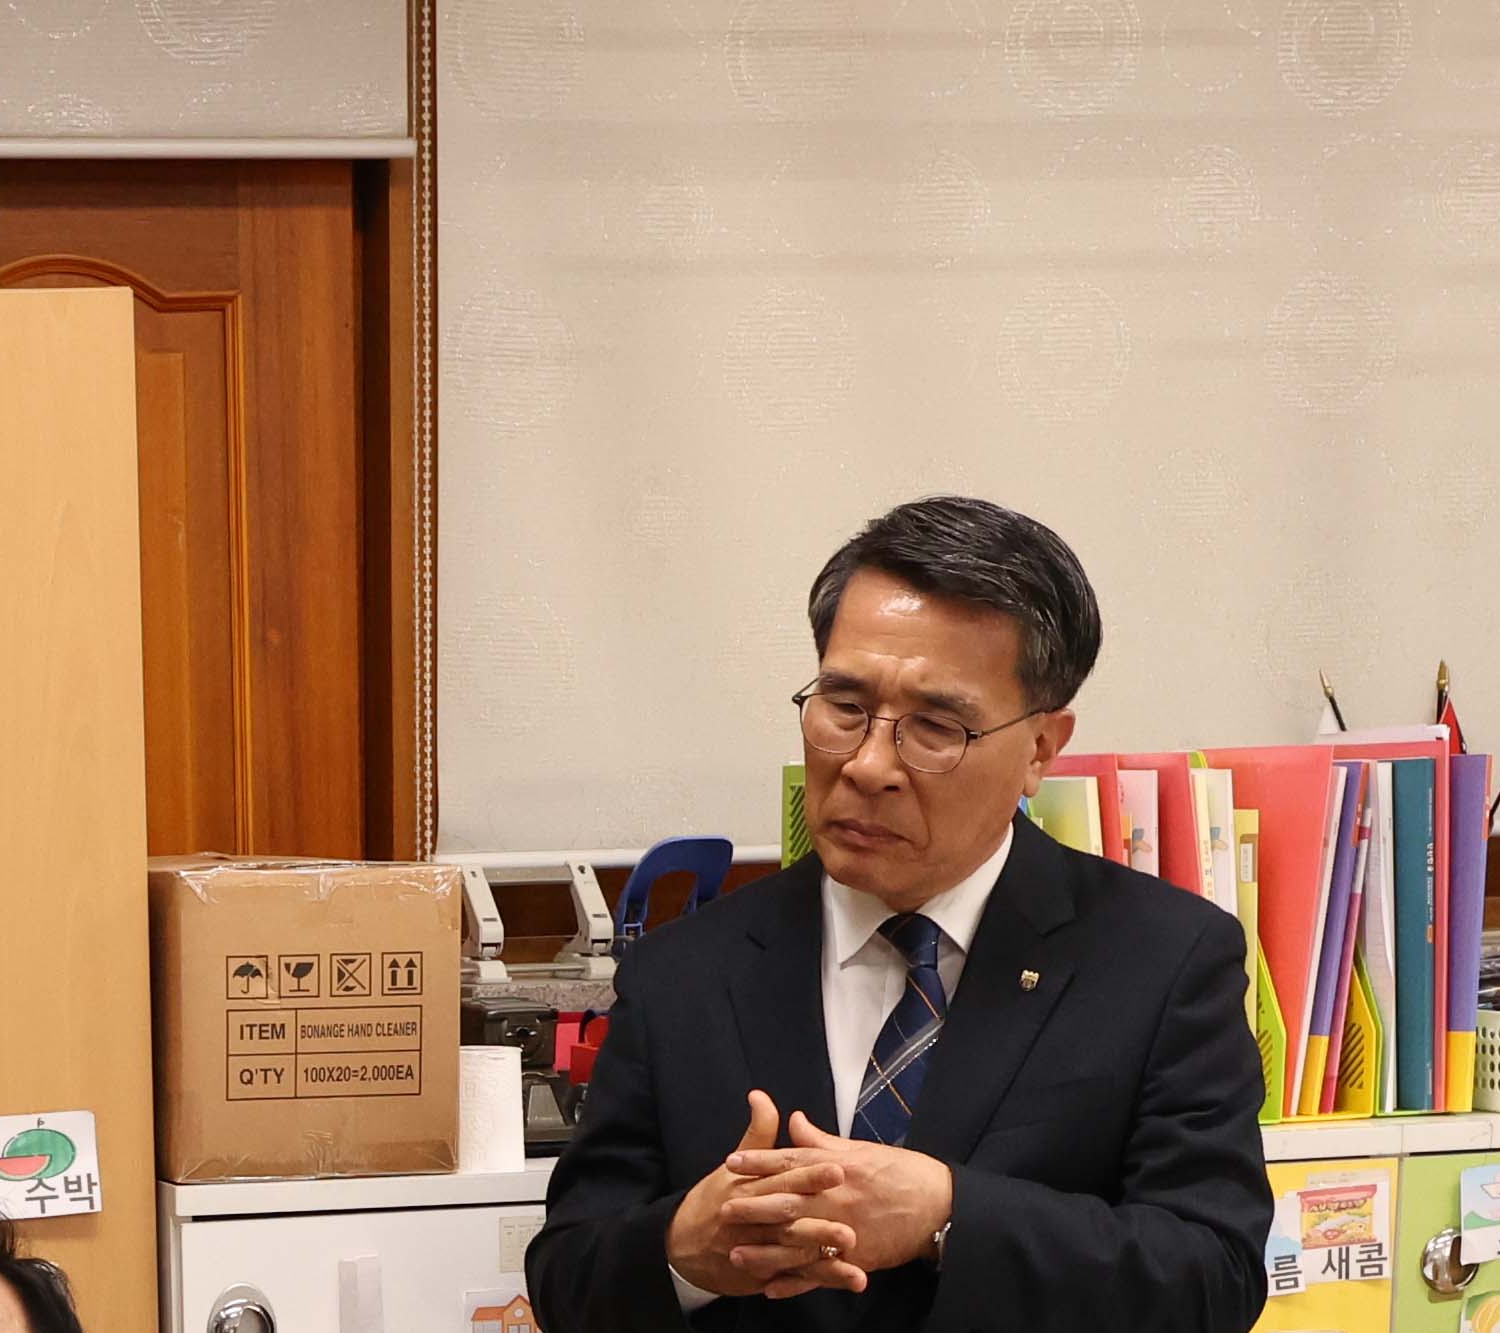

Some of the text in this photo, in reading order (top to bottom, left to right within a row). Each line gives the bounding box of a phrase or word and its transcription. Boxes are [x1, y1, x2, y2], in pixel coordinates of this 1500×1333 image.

[239, 1020, 418, 1041] ITEM BONANGE HAND CLEANER
[239, 1067, 285, 1086] Q'TY
[25, 1172, 99, 1214] 수박
[1269, 1253, 1303, 1292] 름
[1320, 1242, 1388, 1280] 새콤
